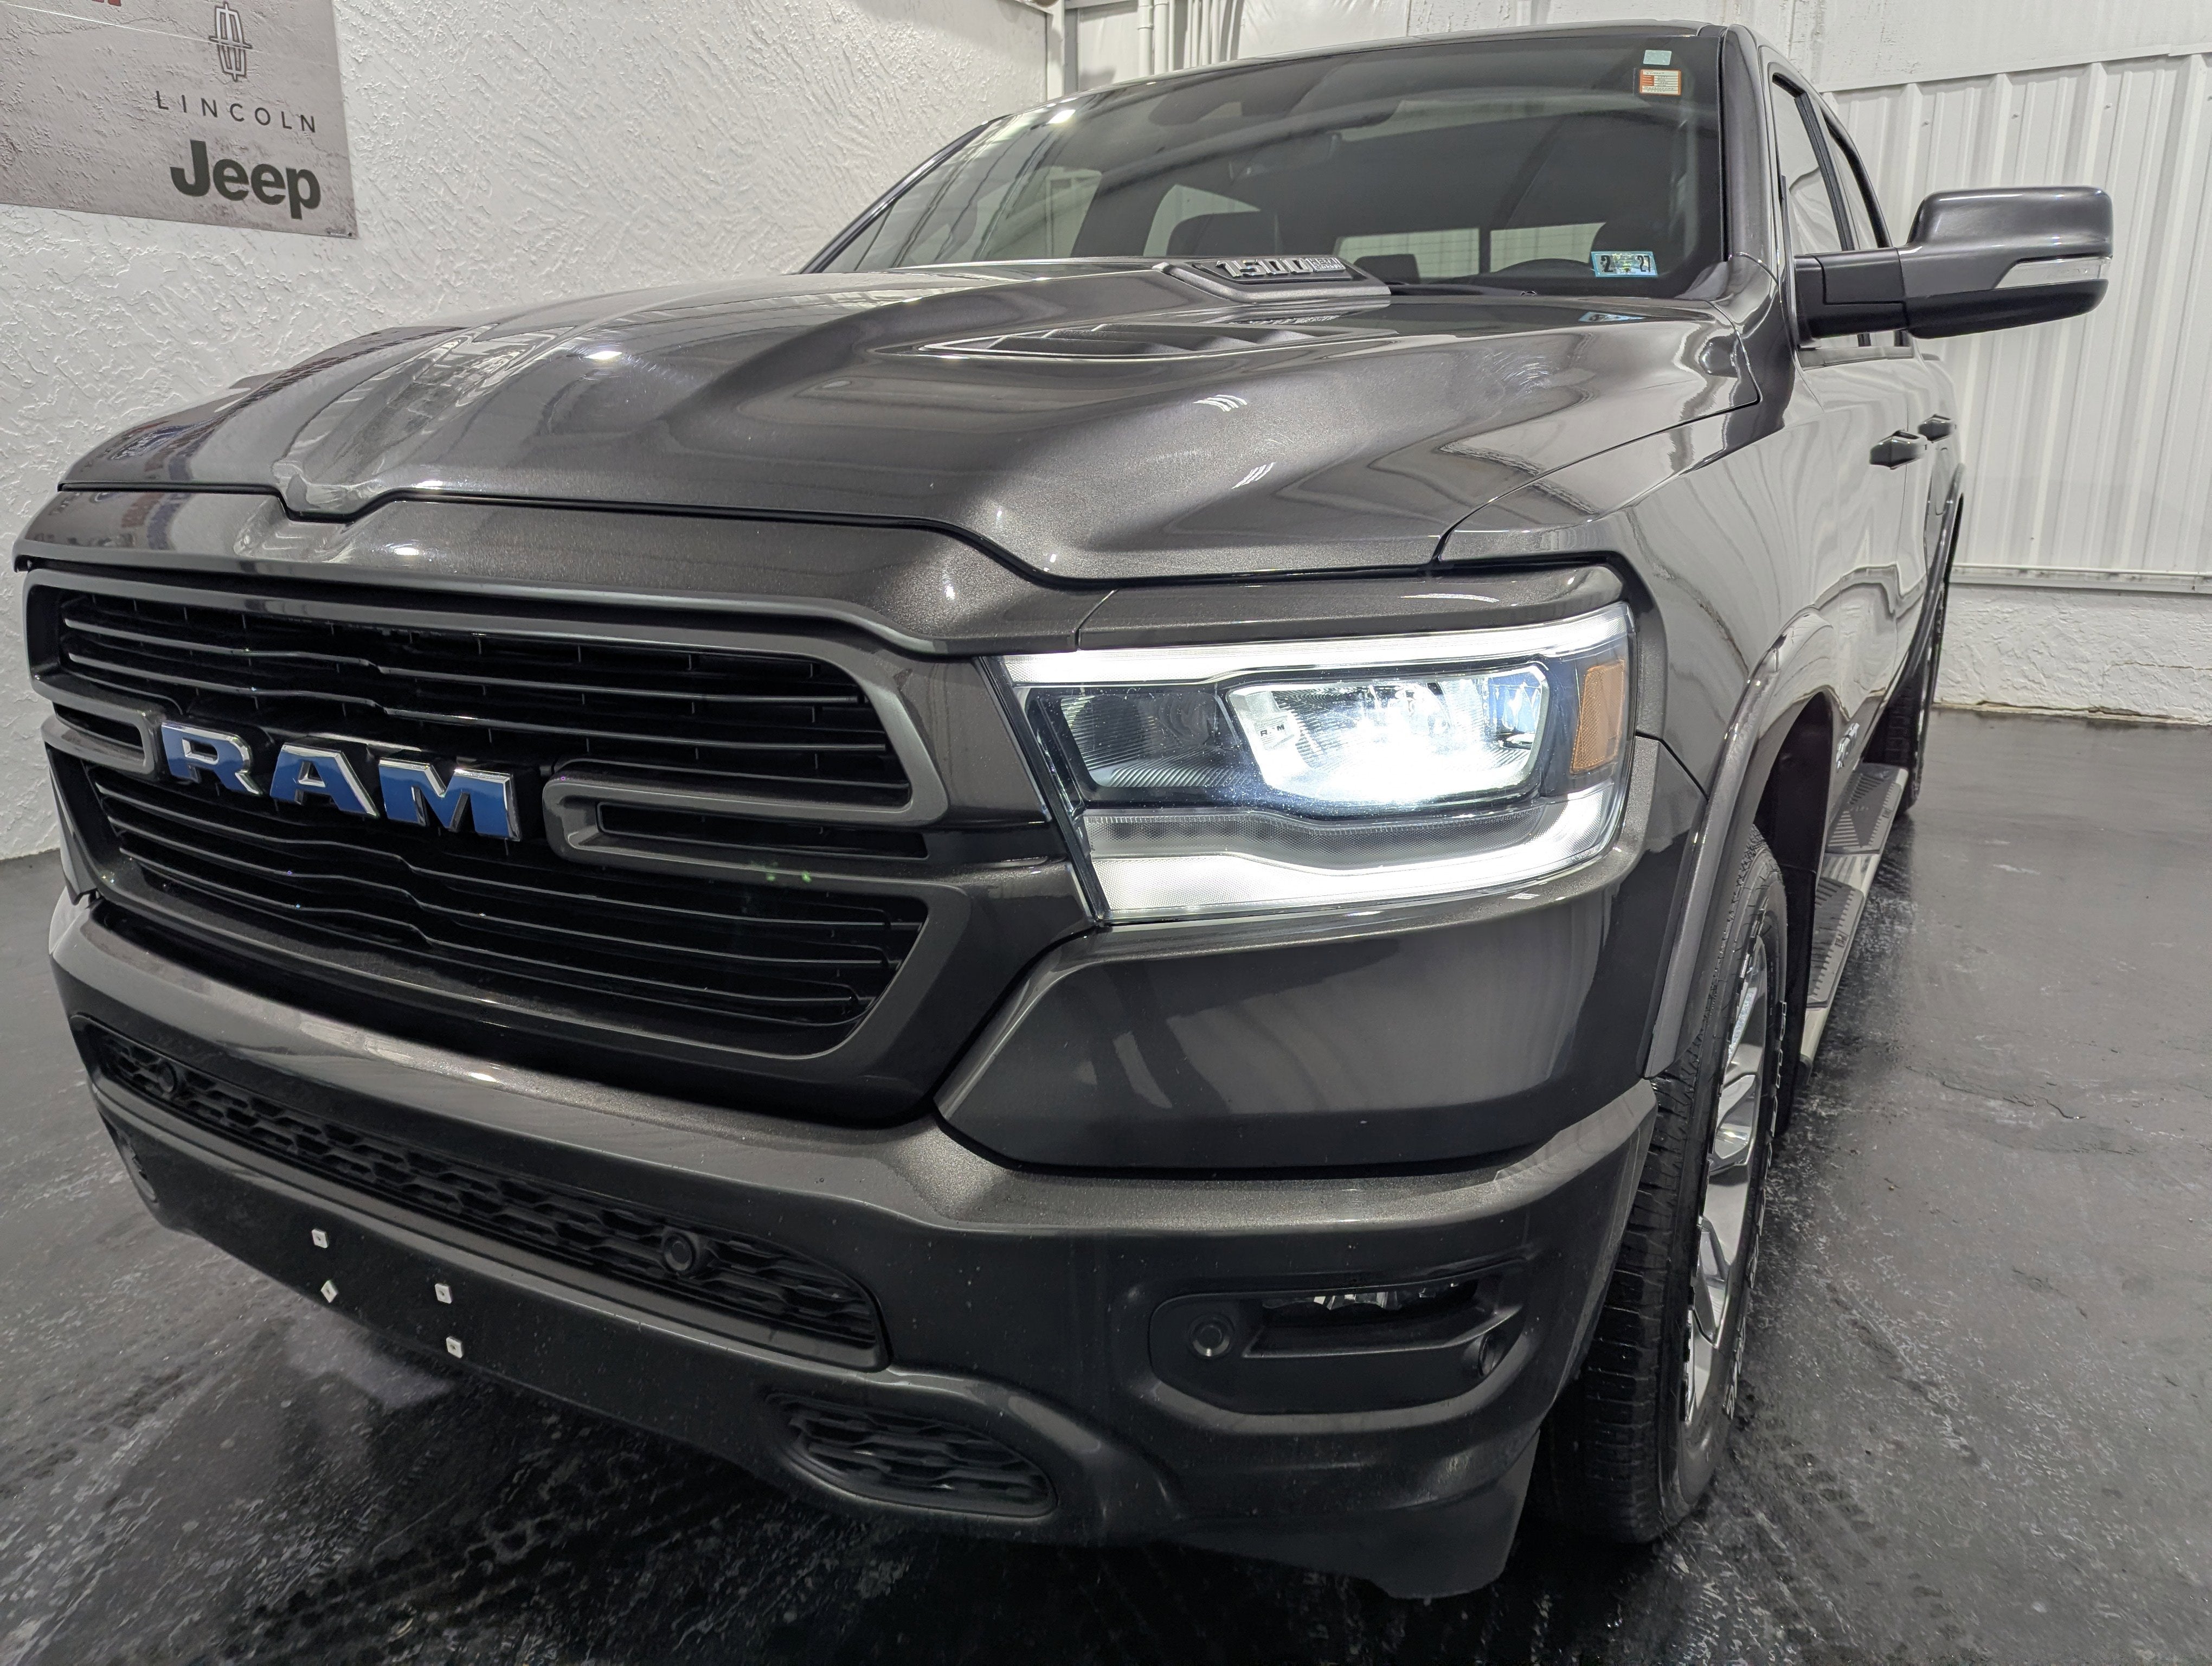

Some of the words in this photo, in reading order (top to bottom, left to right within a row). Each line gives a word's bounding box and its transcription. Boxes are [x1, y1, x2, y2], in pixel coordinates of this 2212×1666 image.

[156, 90, 316, 133] LINCOLN
[169, 139, 321, 220] Jeep
[1216, 258, 1313, 278] 1500
[1600, 254, 1613, 272] 2
[1637, 254, 1651, 272] 27
[1260, 724, 1285, 737] RM
[161, 720, 522, 842] RAM
